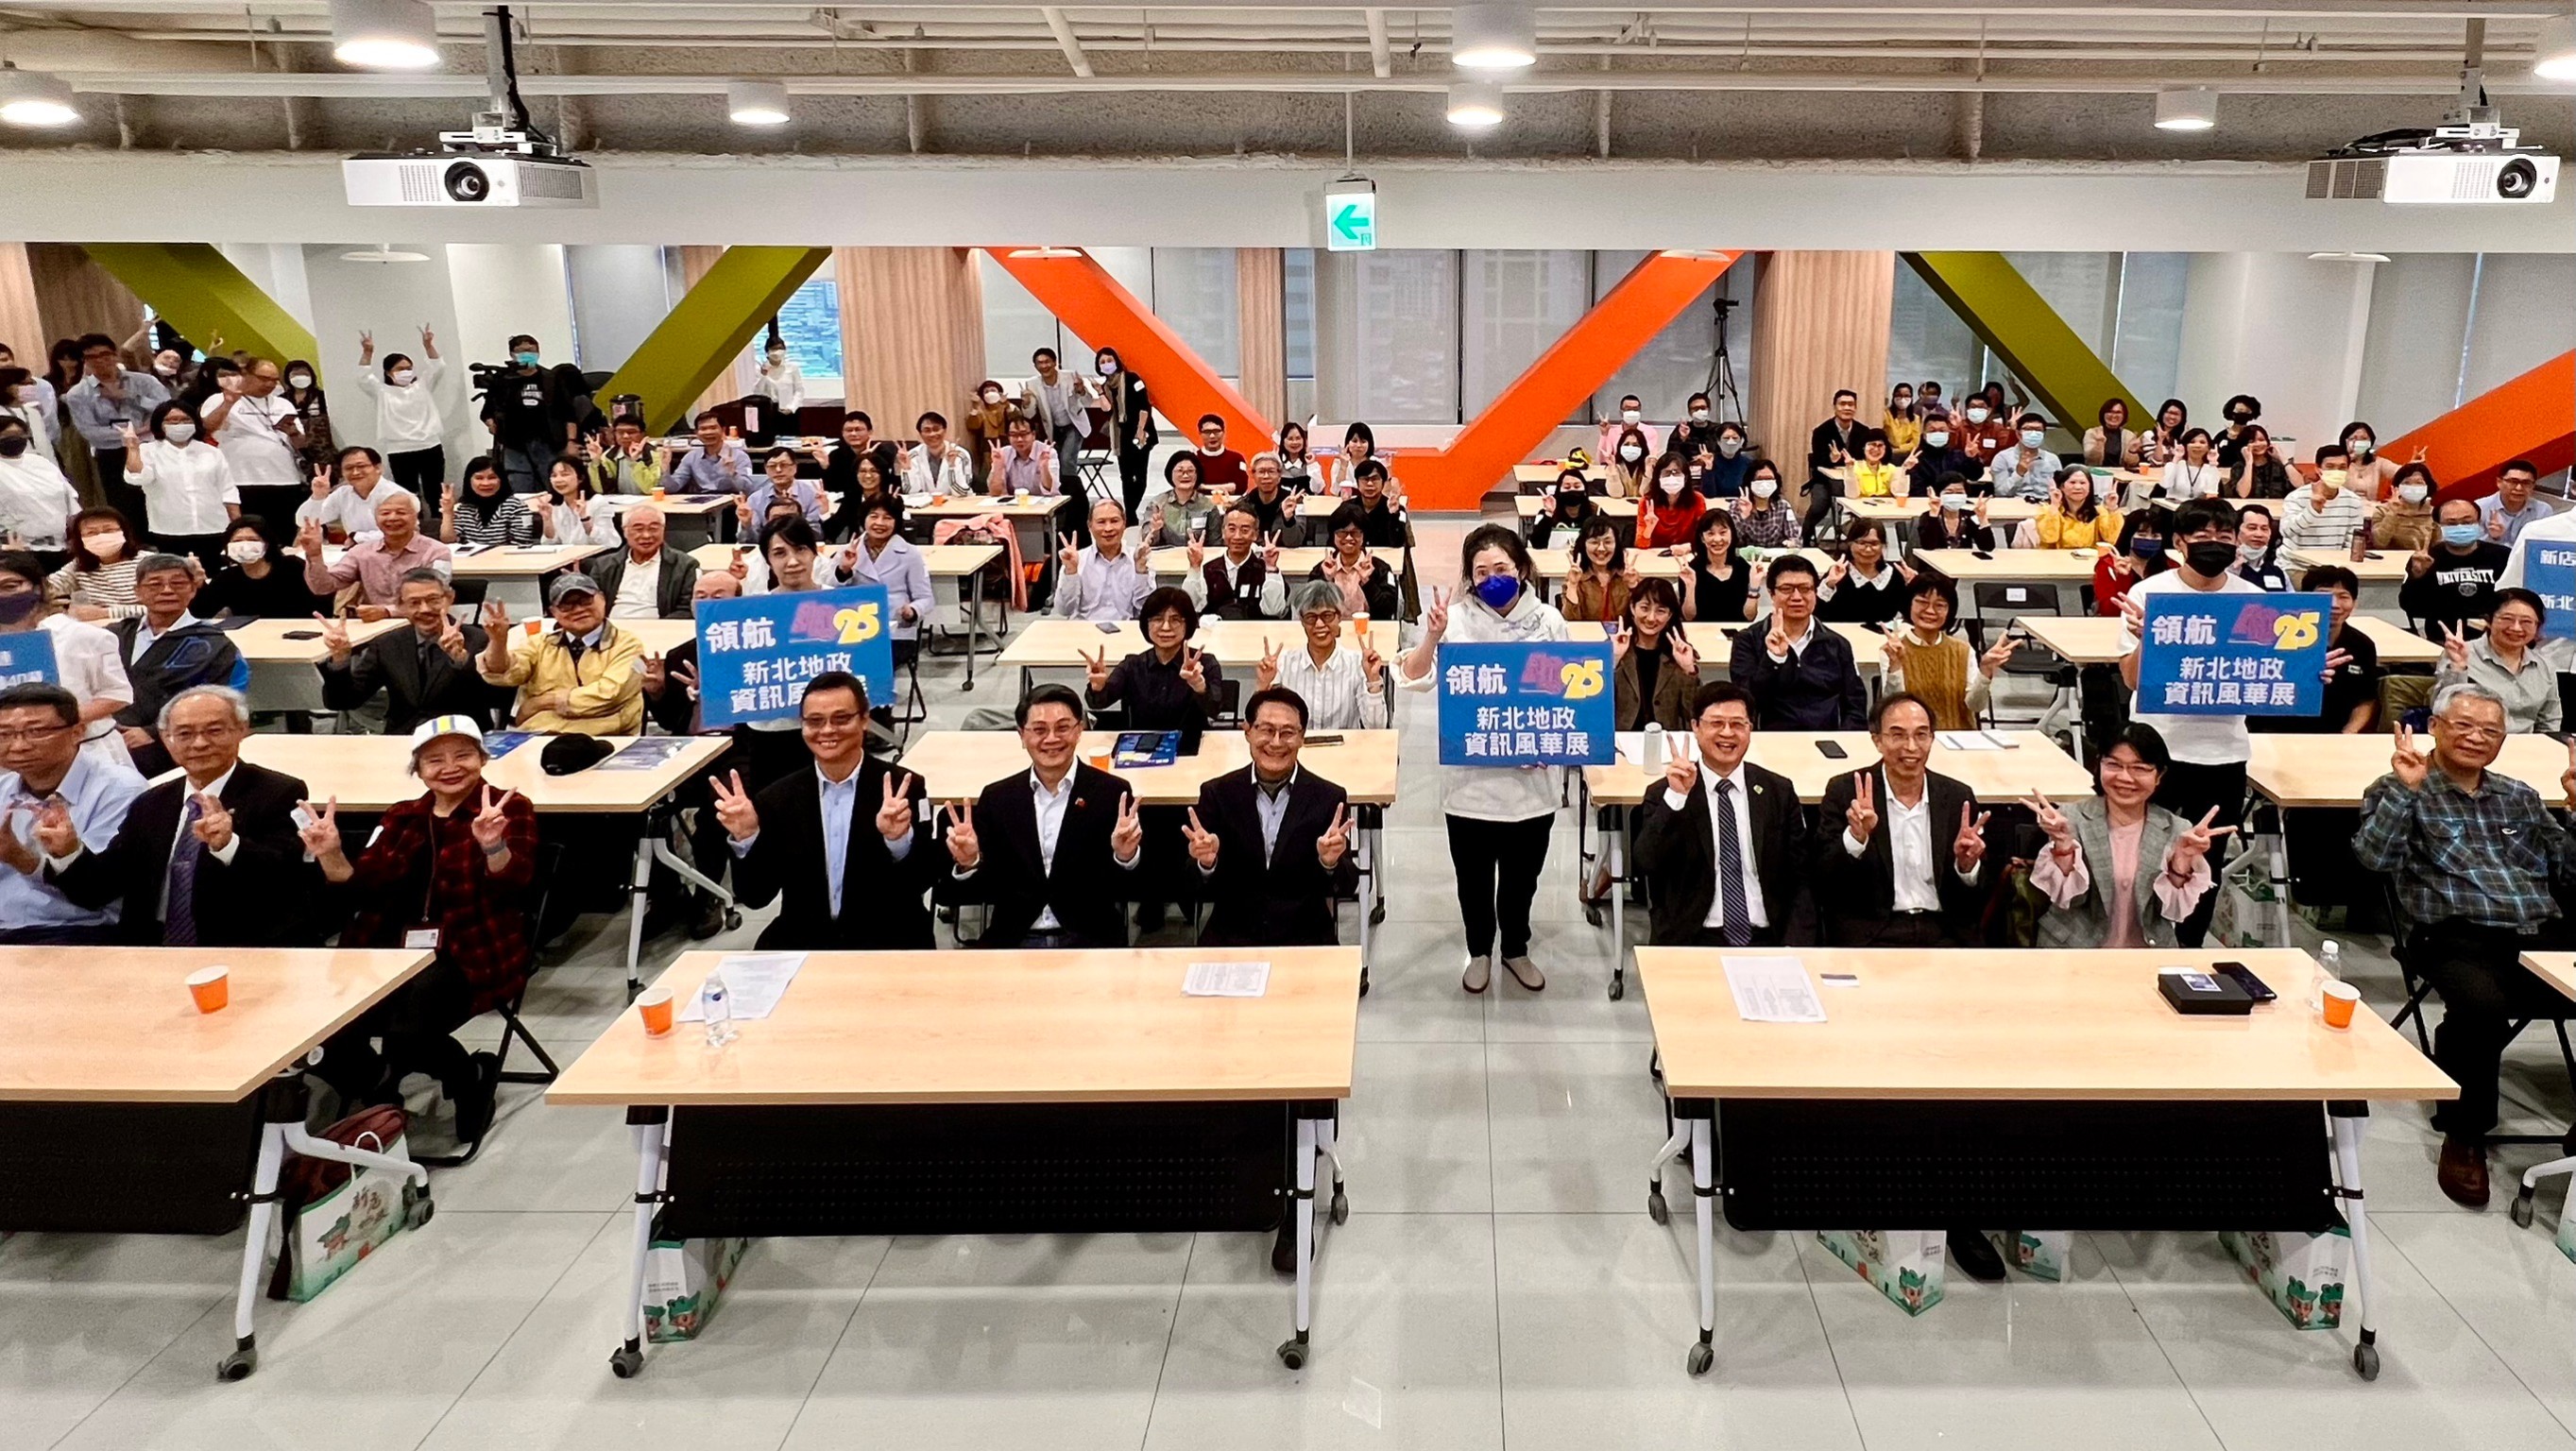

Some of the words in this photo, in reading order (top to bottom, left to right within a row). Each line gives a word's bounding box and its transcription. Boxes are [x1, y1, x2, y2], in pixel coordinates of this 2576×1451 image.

[2436, 569, 2495, 586] UNIVERSITY
[706, 617, 776, 654] 領航
[2151, 615, 2217, 645] 領航
[742, 652, 852, 685] 新北地政
[1445, 663, 1508, 695] 領航
[2179, 657, 2285, 680] 新北地政
[2164, 682, 2295, 706] 資訊風華展
[1476, 706, 1576, 730] 新北地政
[1465, 732, 1590, 757] 資訊風華展
